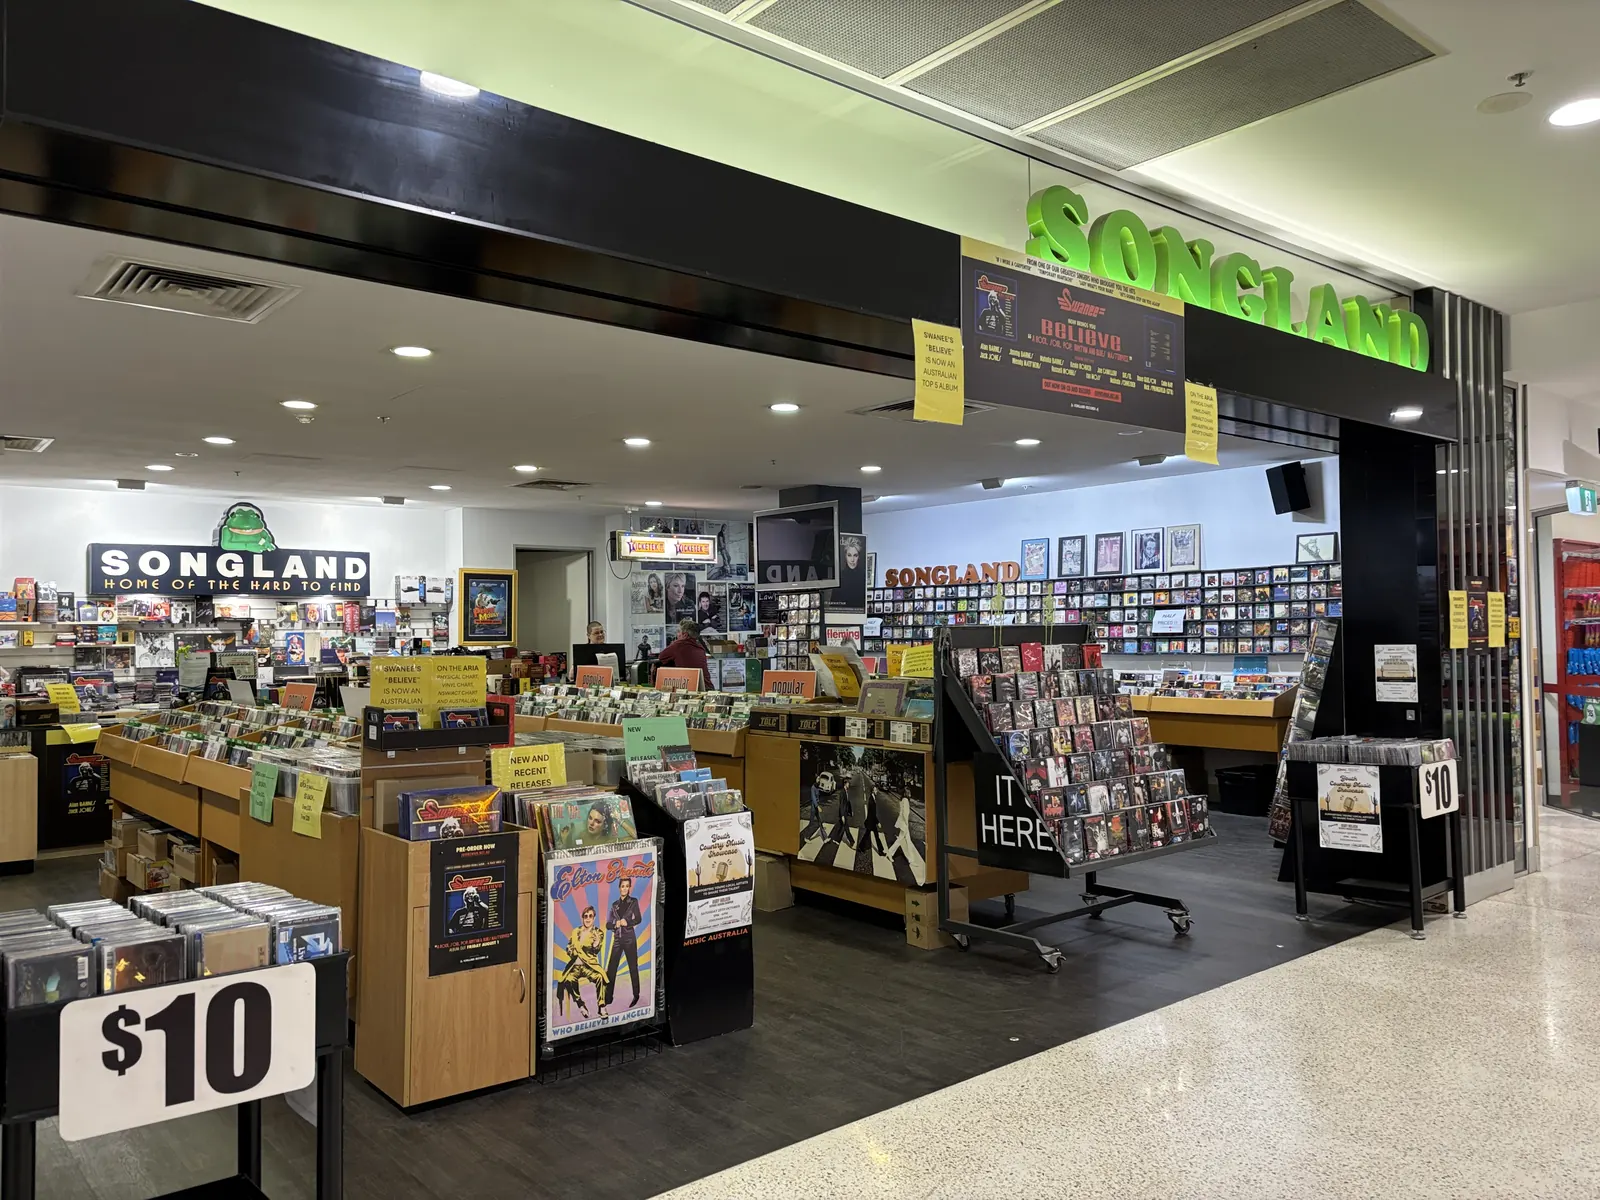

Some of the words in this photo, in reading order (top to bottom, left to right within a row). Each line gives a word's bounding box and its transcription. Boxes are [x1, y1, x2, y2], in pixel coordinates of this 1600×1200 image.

[1026, 184, 1429, 372] SONGLAND
[924, 332, 954, 343] SWANEE'S
[926, 344, 954, 355] "BELIEVE"
[932, 358, 946, 366] NOW
[947, 360, 955, 368] AN
[923, 368, 957, 380] AUSTRALIAN
[922, 379, 933, 387] TOP
[939, 382, 958, 392] ALBUM
[101, 549, 367, 580] SONGLAND
[885, 561, 1020, 588] SONGLAND
[105, 578, 160, 590] HOME
[172, 579, 195, 590] OF
[207, 579, 240, 590] THE
[251, 579, 290, 591] HARD
[301, 581, 321, 591] TO
[330, 581, 361, 591] FIND
[827, 628, 860, 639] fleming
[771, 679, 805, 696] popular
[510, 756, 531, 765] NEW
[515, 767, 547, 777] RECENT
[510, 779, 552, 790] RELEASES
[1425, 764, 1452, 811] $10
[711, 832, 730, 843] Youth
[456, 845, 483, 853] PRE-ORDER
[700, 842, 724, 851] Country
[726, 838, 745, 847] Music
[708, 849, 737, 858] Showcase
[550, 866, 605, 901] Elton
[684, 937, 706, 946] MUSIC
[708, 929, 748, 941] AUSTRALIA
[552, 1027, 572, 1036] WHO
[575, 1019, 610, 1031] BELIEVES
[621, 1008, 651, 1021] ANGELS!
[101, 981, 272, 1107] $10
